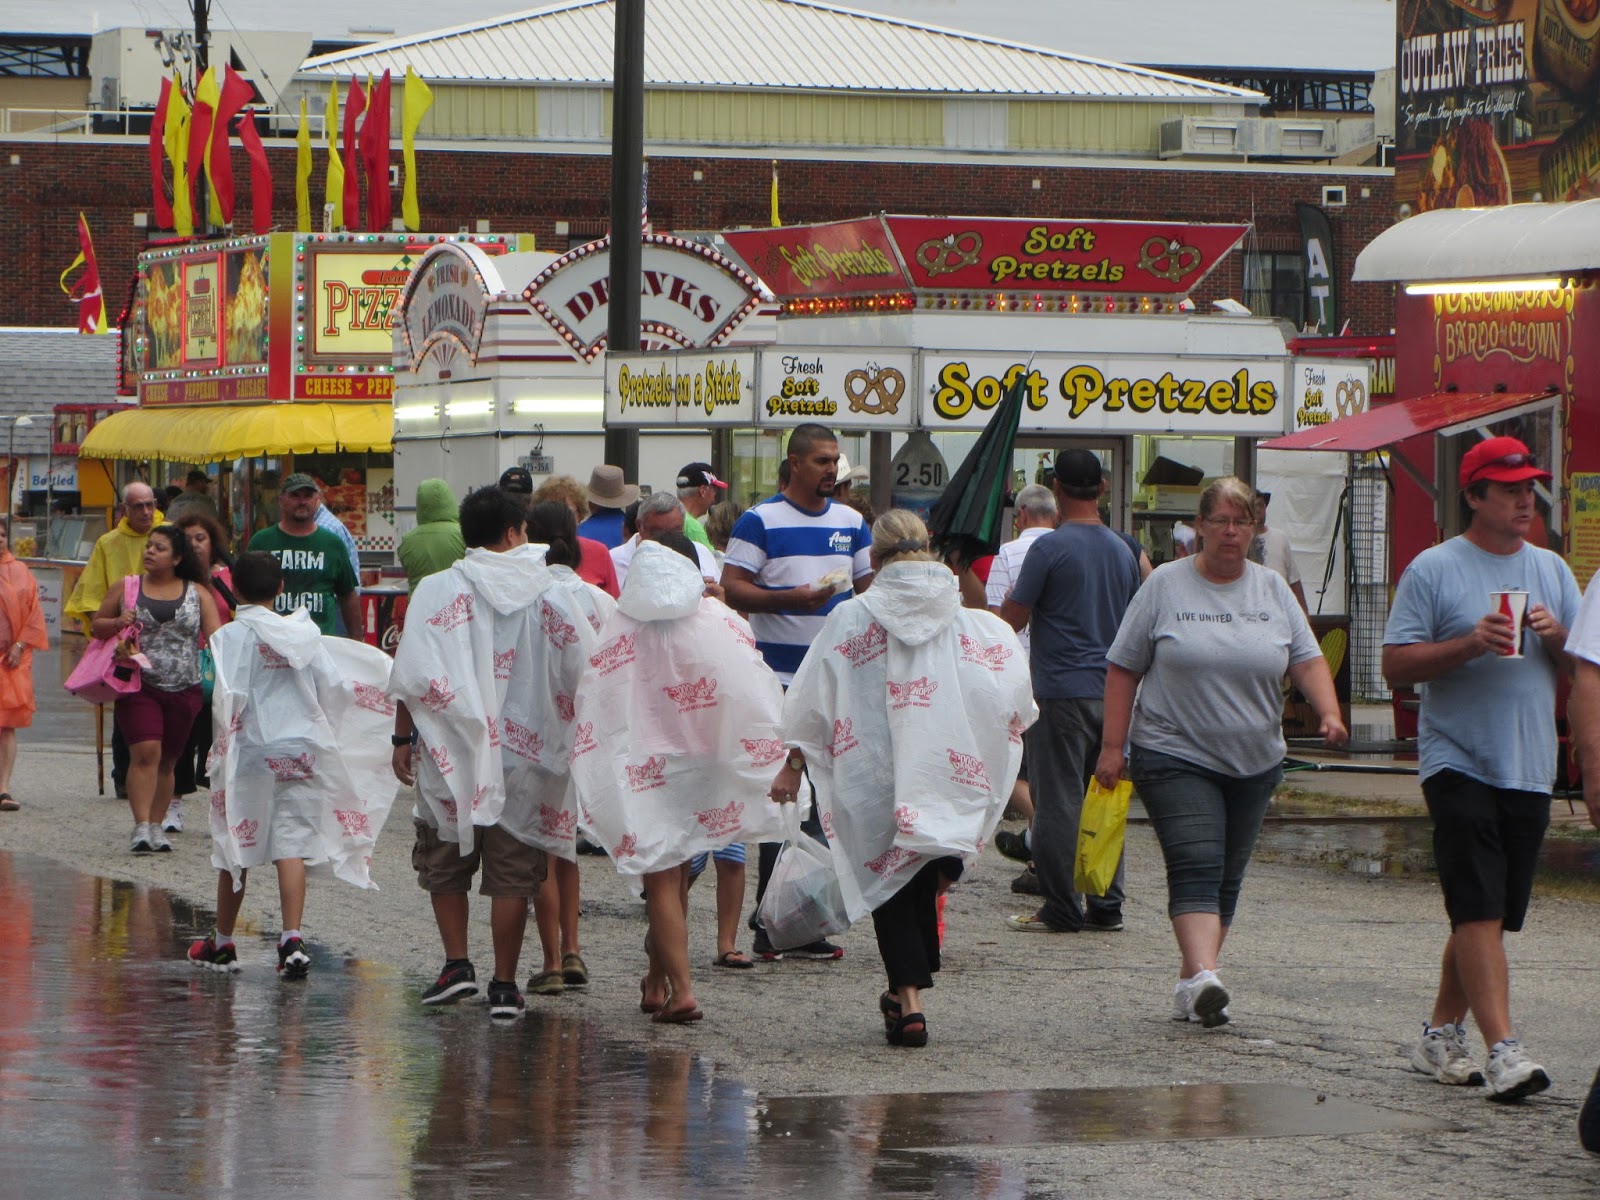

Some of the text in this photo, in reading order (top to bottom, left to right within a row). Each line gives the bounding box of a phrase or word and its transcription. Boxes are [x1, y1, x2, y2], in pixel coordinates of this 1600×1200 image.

[1401, 20, 1526, 94] OUTLAW FRIES
[1023, 226, 1096, 256] Soft
[436, 264, 459, 287] FRESH
[779, 239, 895, 287] Soft Pretzels
[990, 255, 1125, 283] Pretzels
[323, 280, 401, 336] PIZZ
[563, 270, 721, 324] DRNKS
[422, 294, 476, 340] LEMONADE
[1509, 321, 1562, 363] CLOWN
[781, 356, 823, 375] Fresh
[1304, 367, 1326, 386] Fresh
[145, 377, 266, 402] CHEESE PEPPERONI SAUSAGE
[305, 378, 352, 396] CHEESE
[619, 359, 741, 416] Pretzels on a Stick
[781, 376, 820, 399] Soft
[933, 362, 1277, 420] Soft Pretzels
[1304, 387, 1324, 410] Soft
[766, 396, 838, 417] Pretzels
[1297, 406, 1333, 428] Pretzels
[32, 474, 75, 486] Botled
[896, 462, 942, 487] 2.50
[274, 592, 323, 613] OUGH
[1176, 612, 1232, 624] LIVE UNITED
